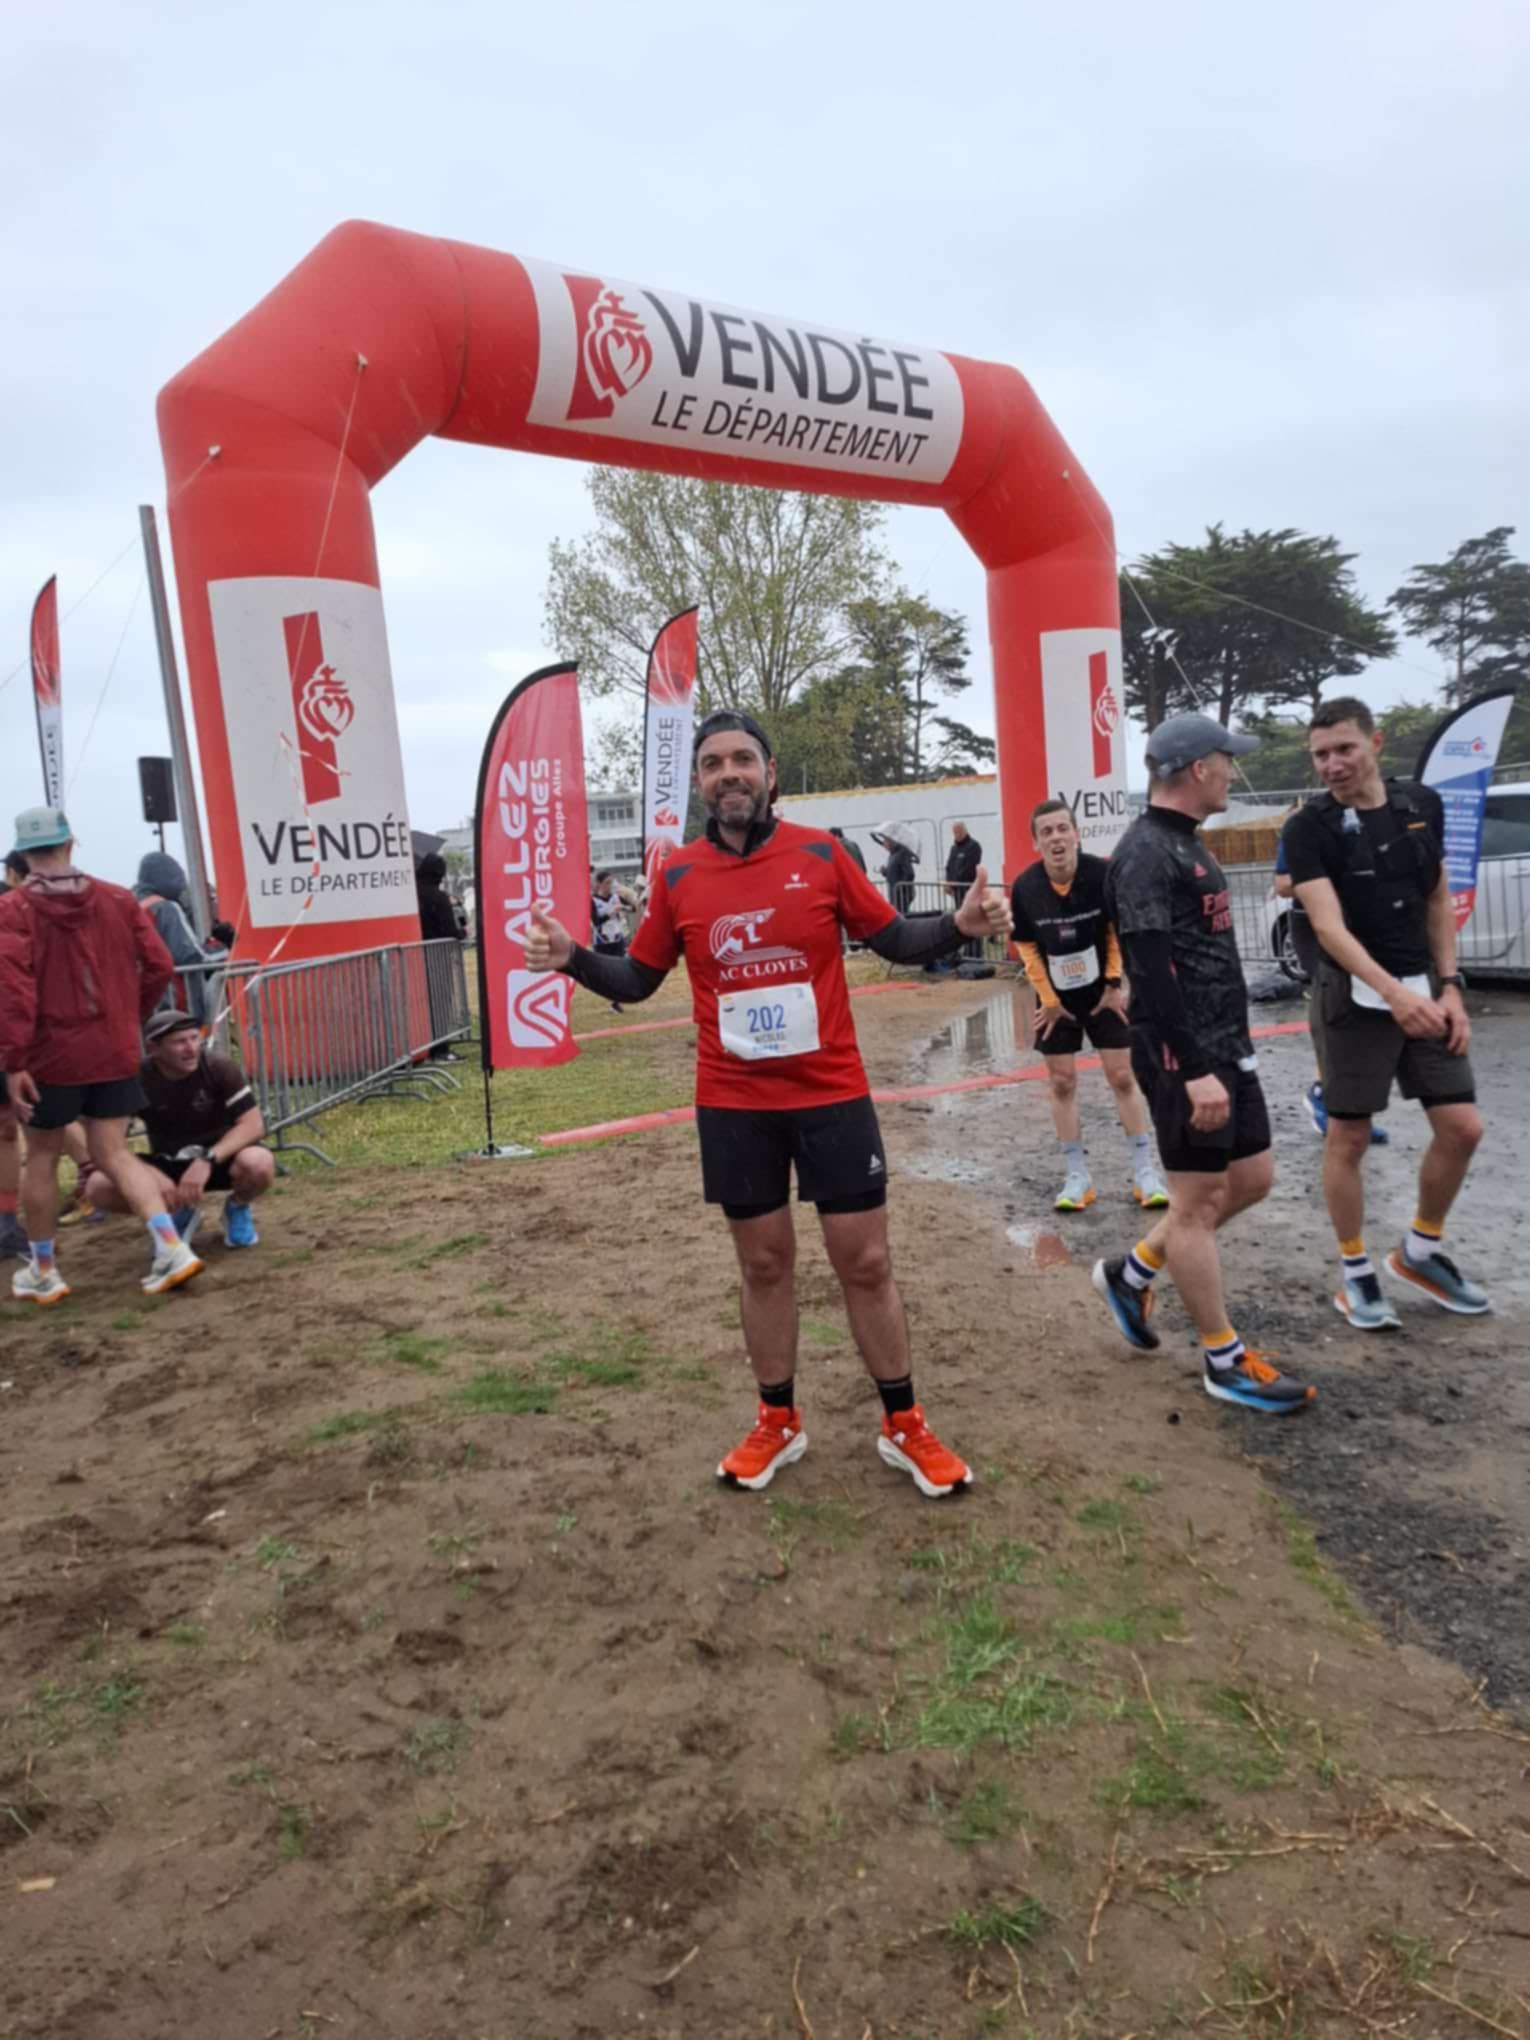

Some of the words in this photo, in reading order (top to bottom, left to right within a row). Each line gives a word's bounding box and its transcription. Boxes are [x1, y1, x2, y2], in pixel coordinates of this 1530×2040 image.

[641, 289, 934, 421] VENDÉE
[651, 390, 697, 431] LE
[701, 398, 930, 466] DÉPARTEMENT
[553, 758, 563, 797] Allez
[655, 717, 674, 805] VENDÉE
[251, 812, 410, 866] VENDÉE
[499, 759, 532, 946] ALLEZ
[530, 757, 555, 915] NERGIES
[555, 801, 568, 859] Groupe
[261, 877, 283, 897] LE
[719, 966, 739, 982] AC
[742, 956, 809, 979] CLOYES
[747, 1003, 787, 1034] 202
